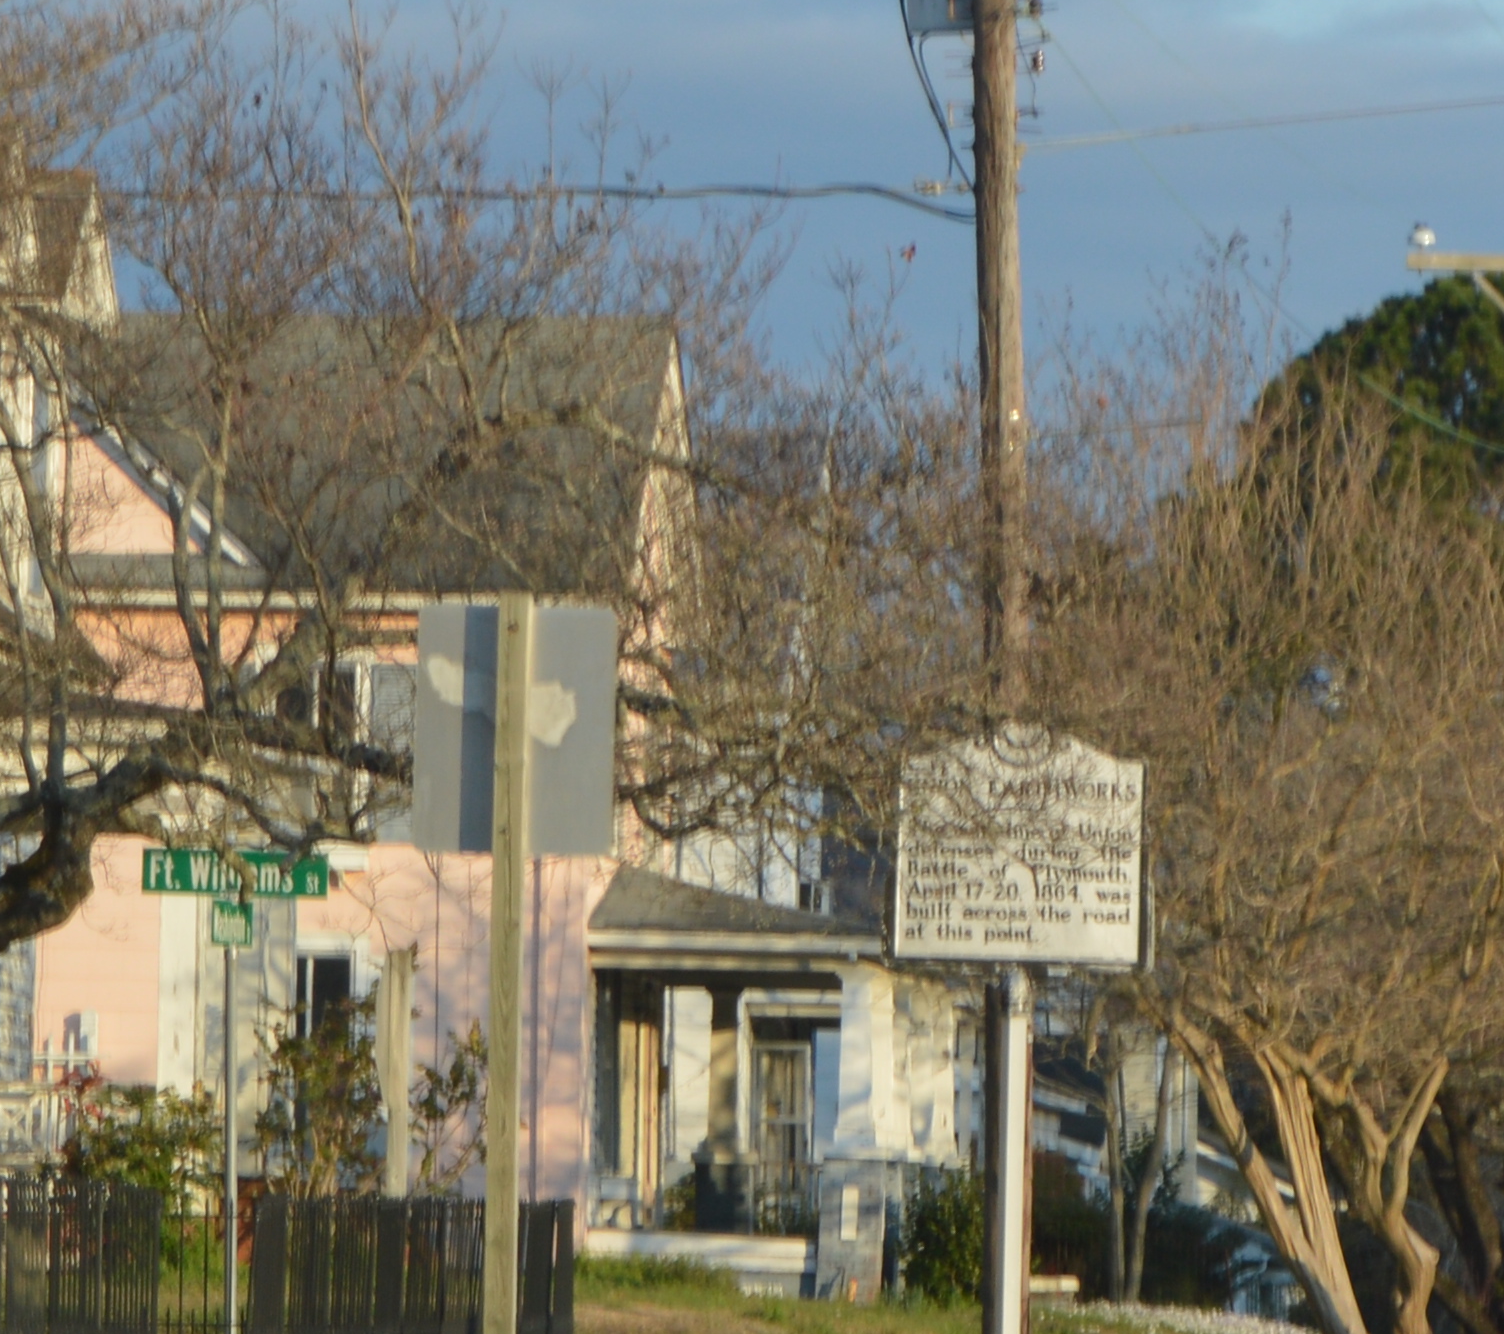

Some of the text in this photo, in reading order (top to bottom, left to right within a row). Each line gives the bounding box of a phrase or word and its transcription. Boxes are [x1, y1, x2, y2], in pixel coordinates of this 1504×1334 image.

[1015, 842, 1078, 863] during
[1100, 843, 1132, 860] the
[150, 851, 180, 890] Ft.
[305, 872, 320, 894] St
[907, 860, 967, 877] Battle
[990, 863, 1008, 878] of
[907, 880, 957, 899] April
[1096, 891, 1131, 904] was
[906, 901, 1130, 925] built across the road
[906, 925, 924, 939] at
[937, 924, 972, 940] this
